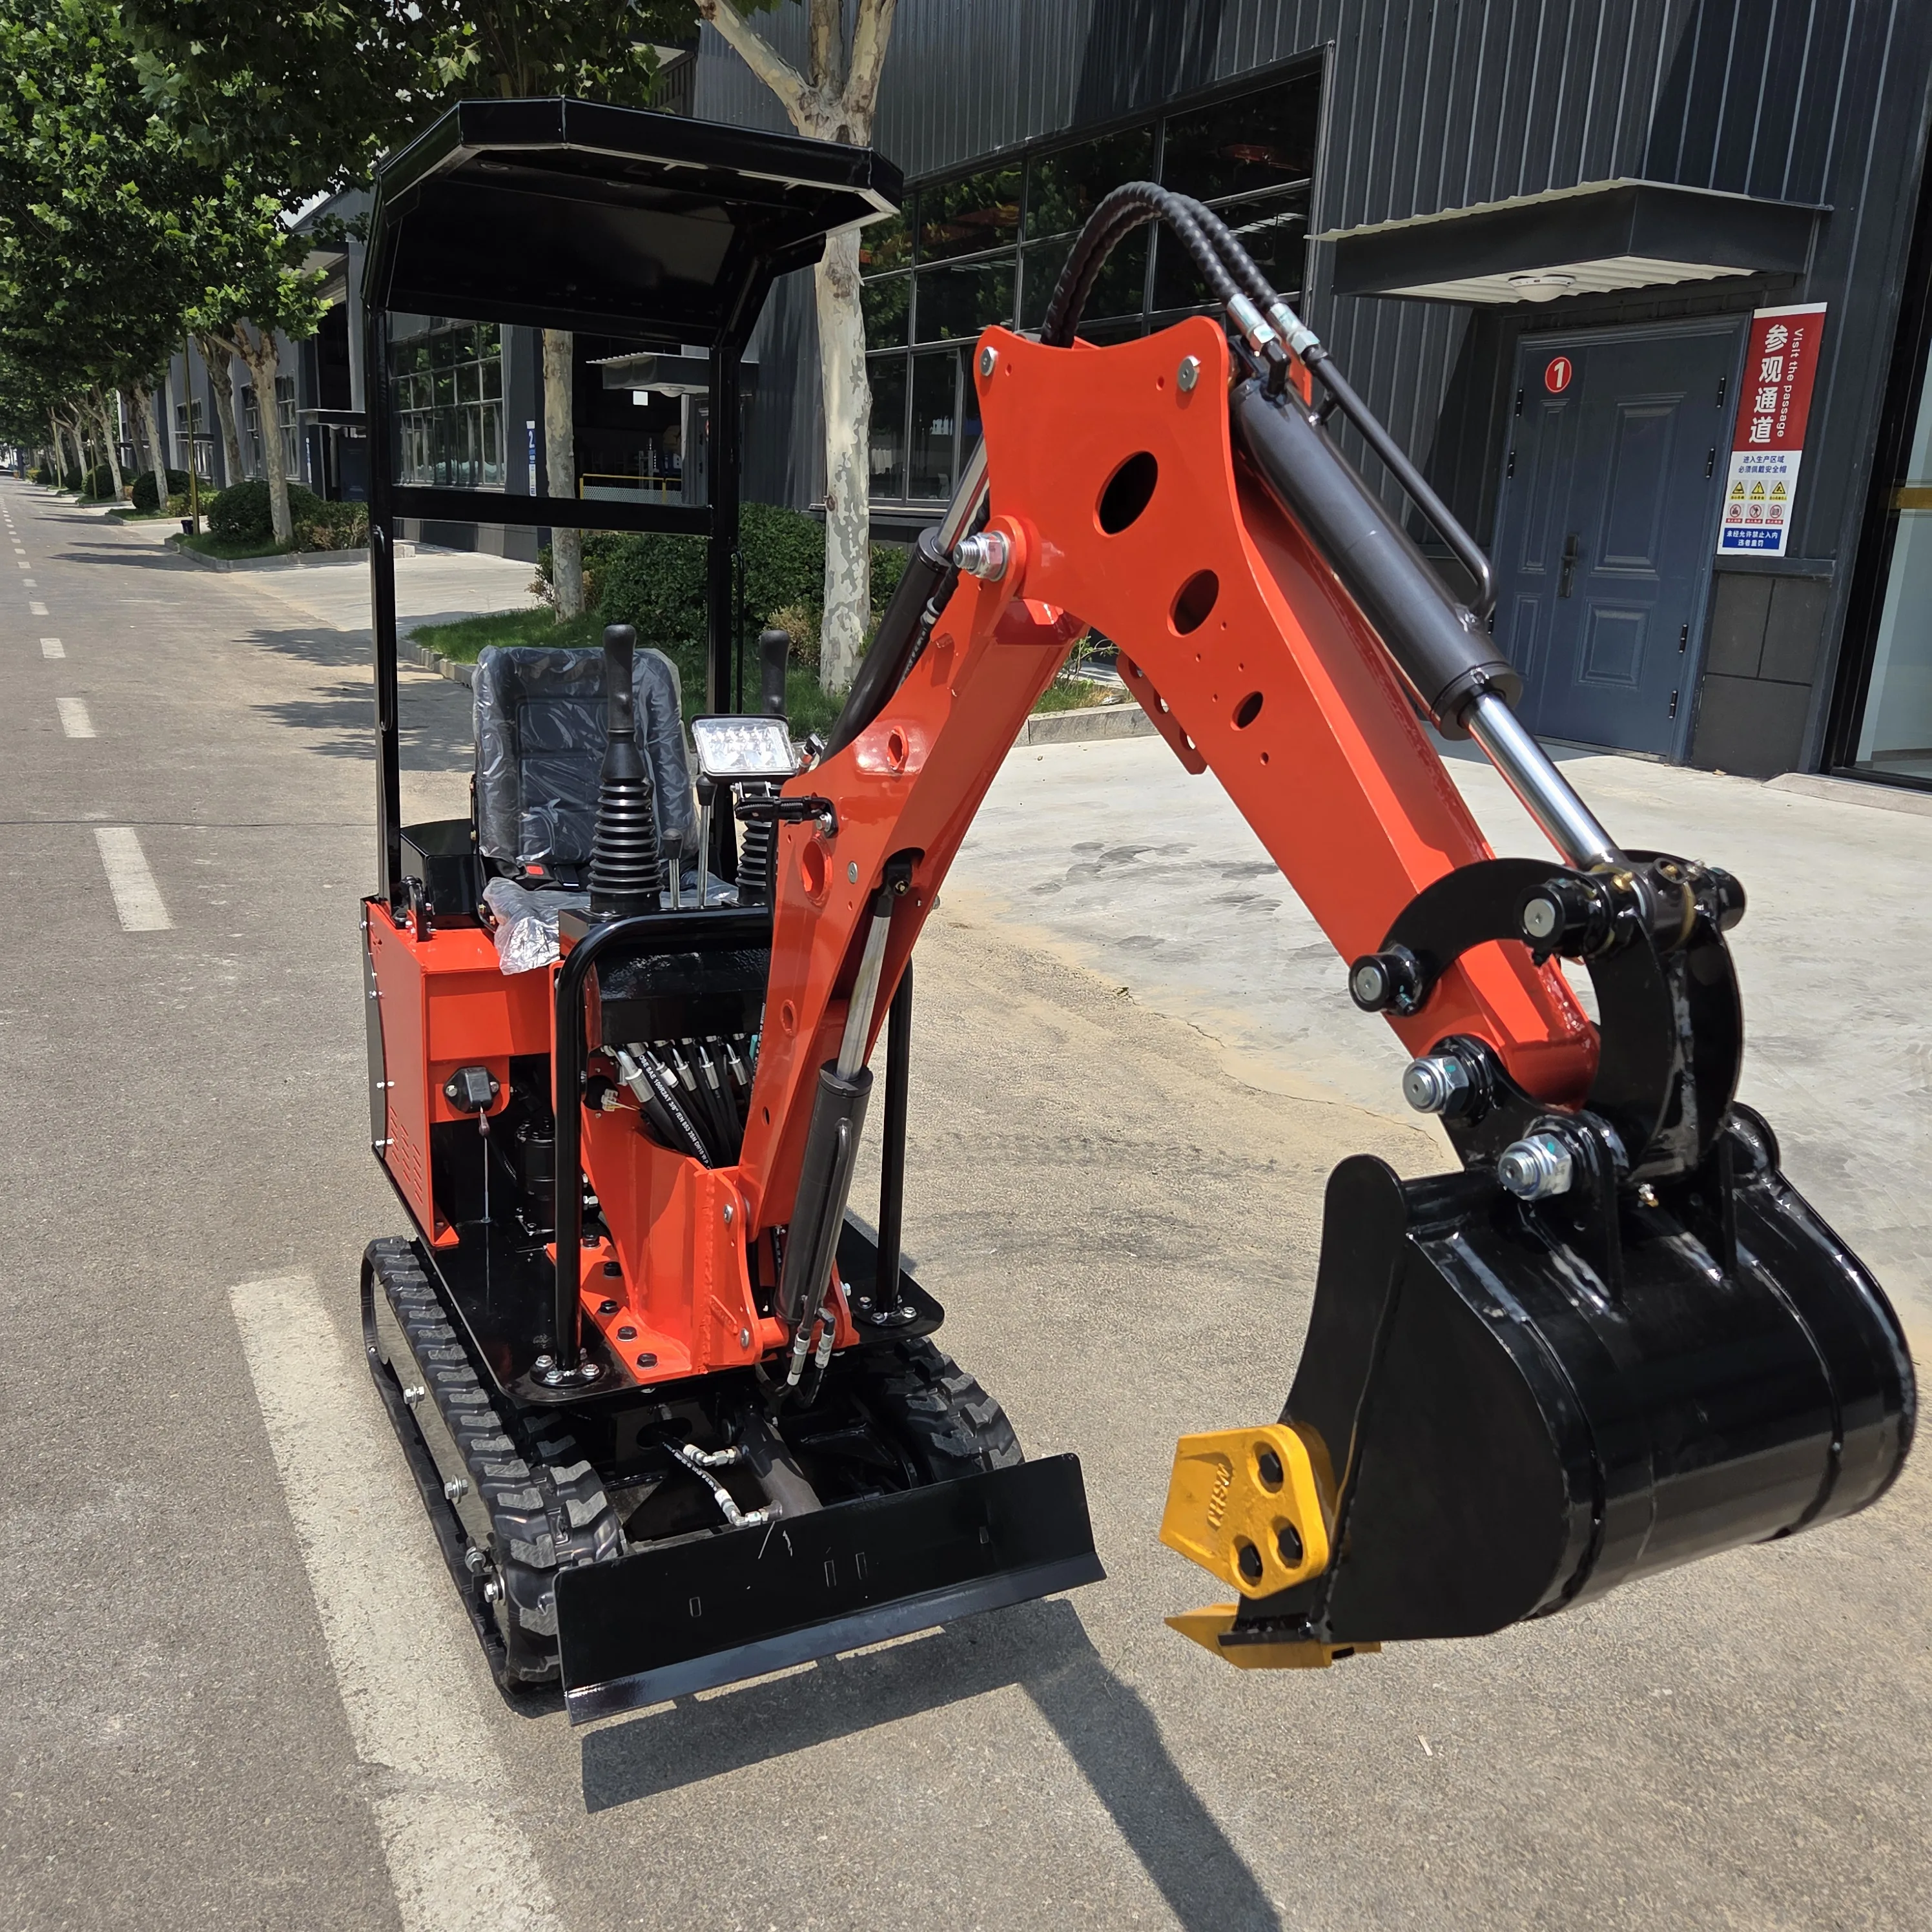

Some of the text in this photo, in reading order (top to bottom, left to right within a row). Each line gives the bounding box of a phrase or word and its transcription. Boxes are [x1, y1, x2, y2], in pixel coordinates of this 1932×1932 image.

[1554, 362, 1565, 387] 1
[1749, 324, 1788, 444] 参观通道
[1776, 328, 1804, 437] Visit the passage
[529, 431, 535, 448] 2
[1727, 530, 1778, 539] 未经允许禁止入内
[639, 1054, 650, 1067] OSE
[646, 1067, 656, 1079] SAE
